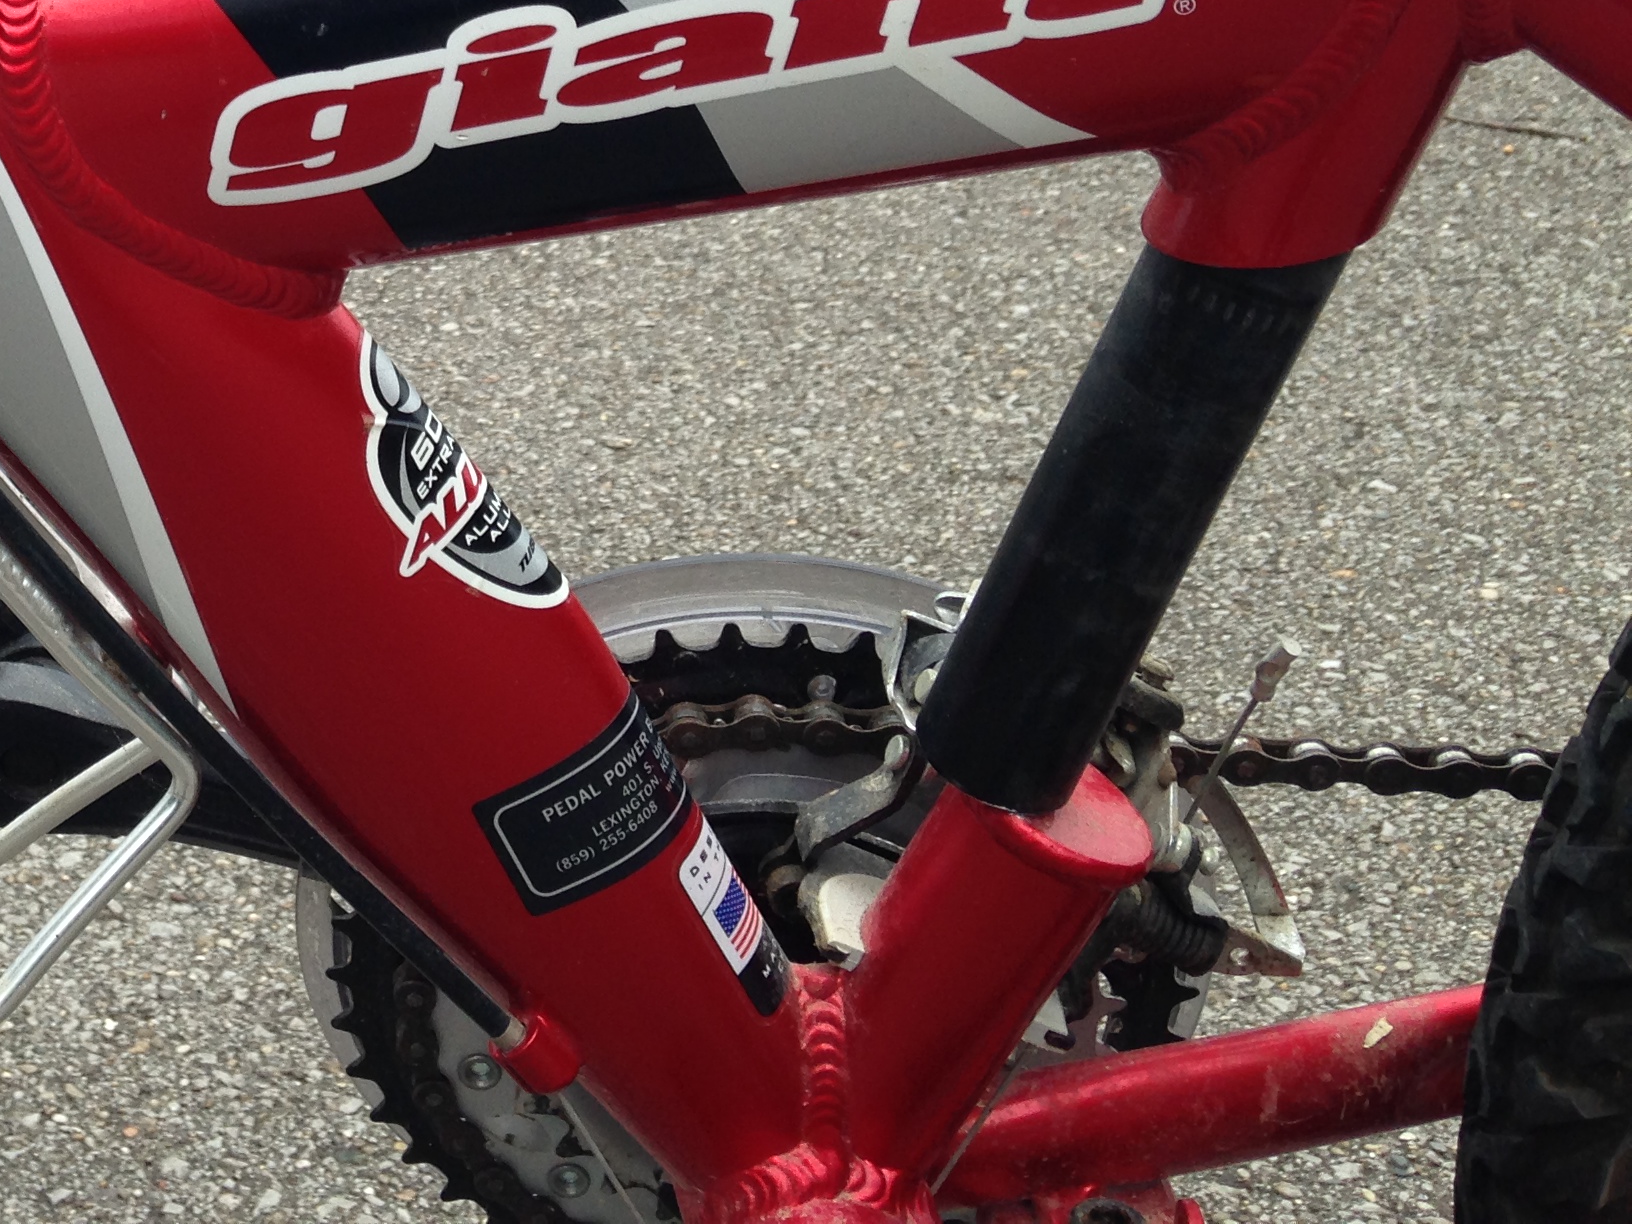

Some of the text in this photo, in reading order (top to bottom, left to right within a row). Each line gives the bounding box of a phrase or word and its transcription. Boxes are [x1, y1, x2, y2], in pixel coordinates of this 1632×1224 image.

[416, 435, 456, 500] EXTRA
[541, 784, 602, 823] PEDAL
[603, 731, 650, 787] POWER
[621, 772, 644, 797] 401
[555, 799, 659, 873] (859) 255-6408
